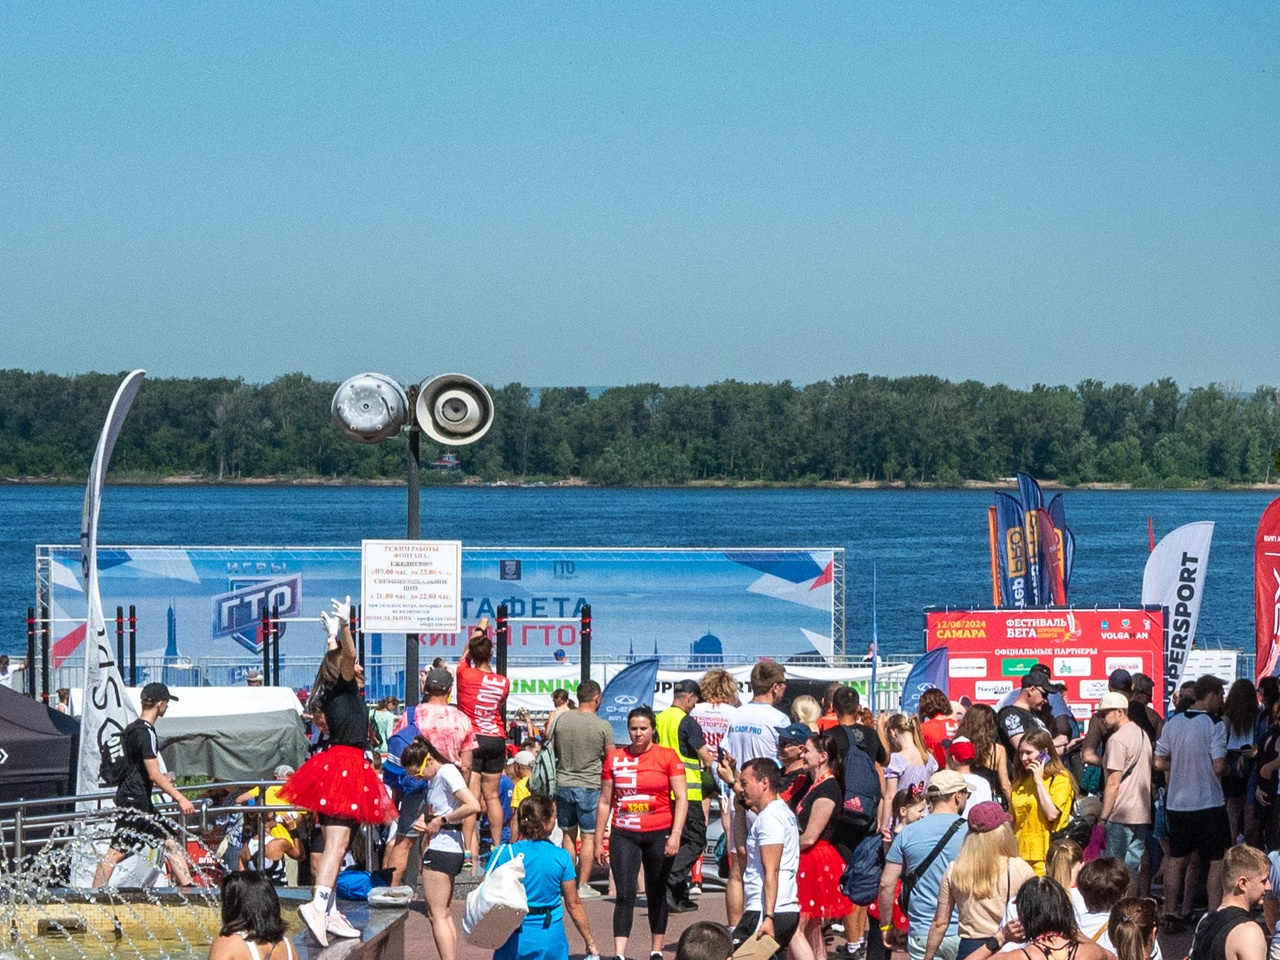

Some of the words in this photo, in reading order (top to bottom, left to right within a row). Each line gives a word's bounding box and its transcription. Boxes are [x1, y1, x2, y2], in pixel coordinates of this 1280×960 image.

[226, 562, 287, 574] ИГРЫ
[220, 585, 292, 628] ГТО
[1006, 618, 1067, 627] ФЕСТИВАЛЬ
[1167, 552, 1199, 700] UPERSPORT
[936, 629, 987, 639] САМАРА
[1006, 628, 1037, 638] БЕГА
[1054, 647, 1098, 655] ПАРТНЕРЫ
[475, 675, 506, 710] LOVE
[613, 756, 639, 788] LIFE
[627, 803, 650, 813] 3263
